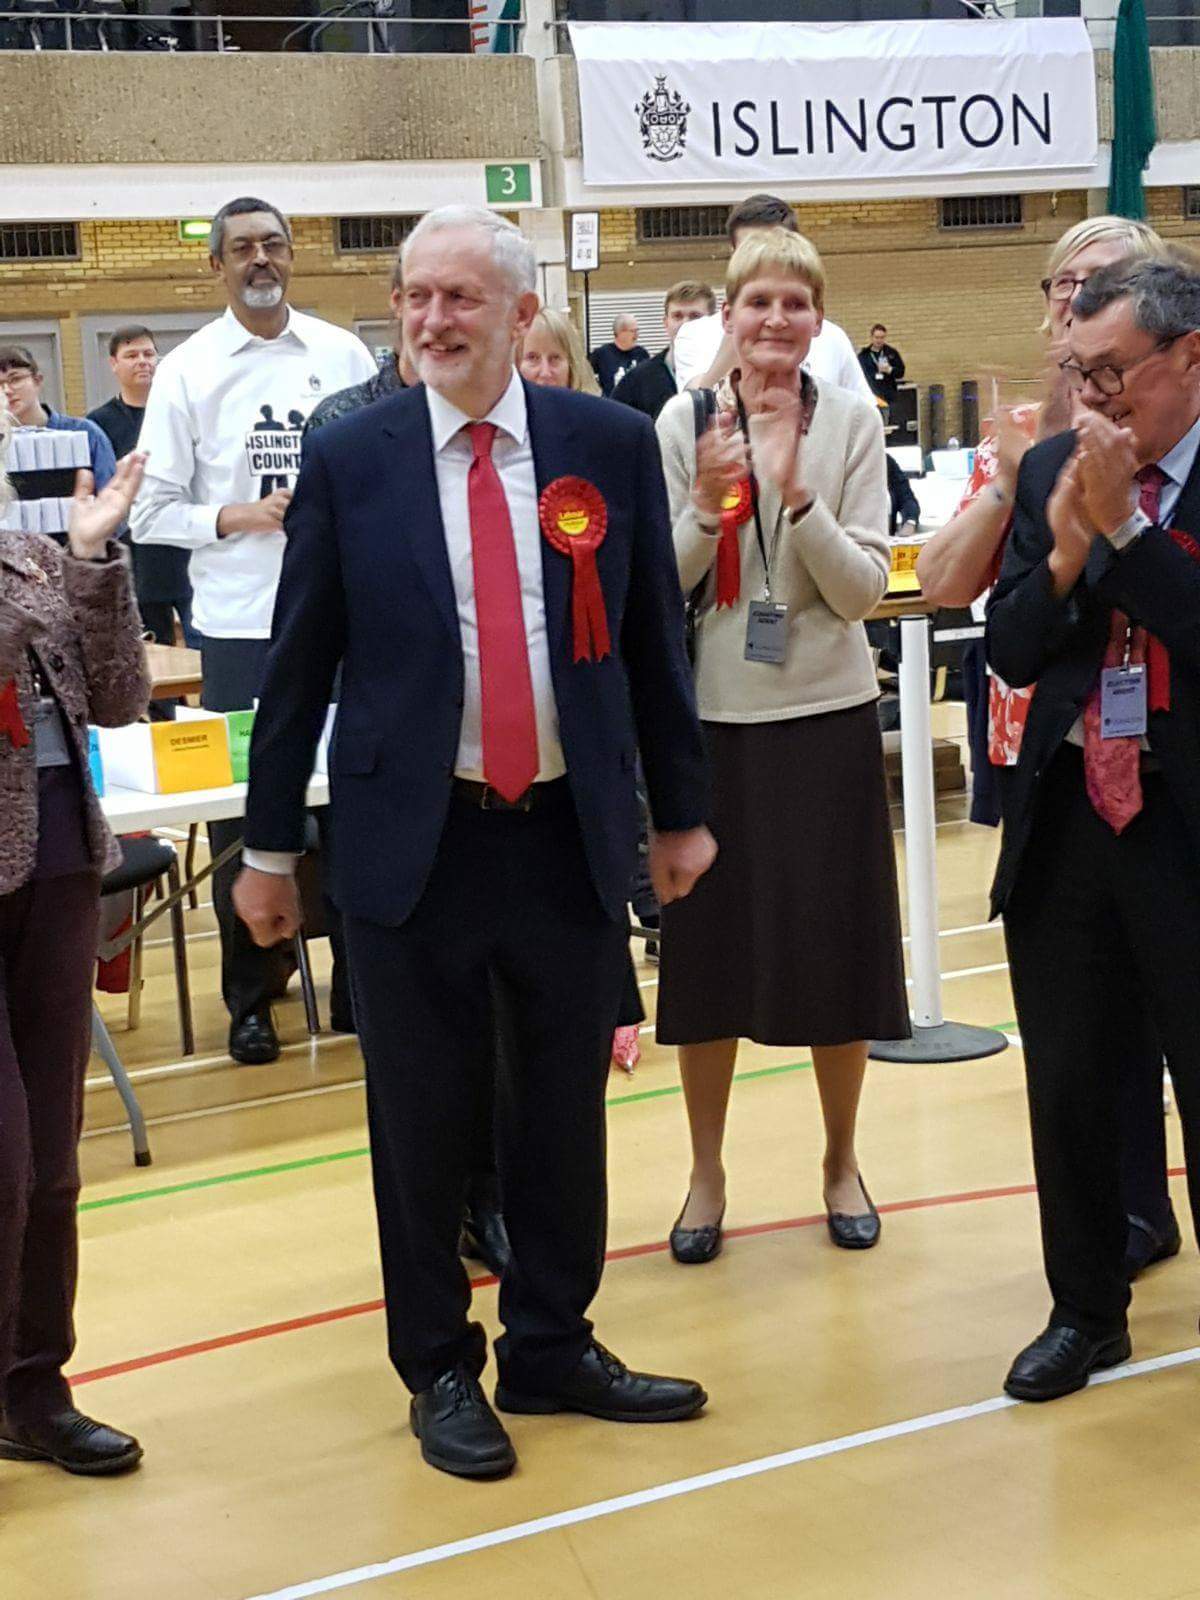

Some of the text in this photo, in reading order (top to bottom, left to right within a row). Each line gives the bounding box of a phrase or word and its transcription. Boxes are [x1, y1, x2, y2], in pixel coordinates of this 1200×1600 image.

[712, 92, 1051, 157] ISLINGTON
[501, 166, 517, 195] 3
[250, 435, 299, 449] ISLINGT
[252, 452, 301, 470] COUNT
